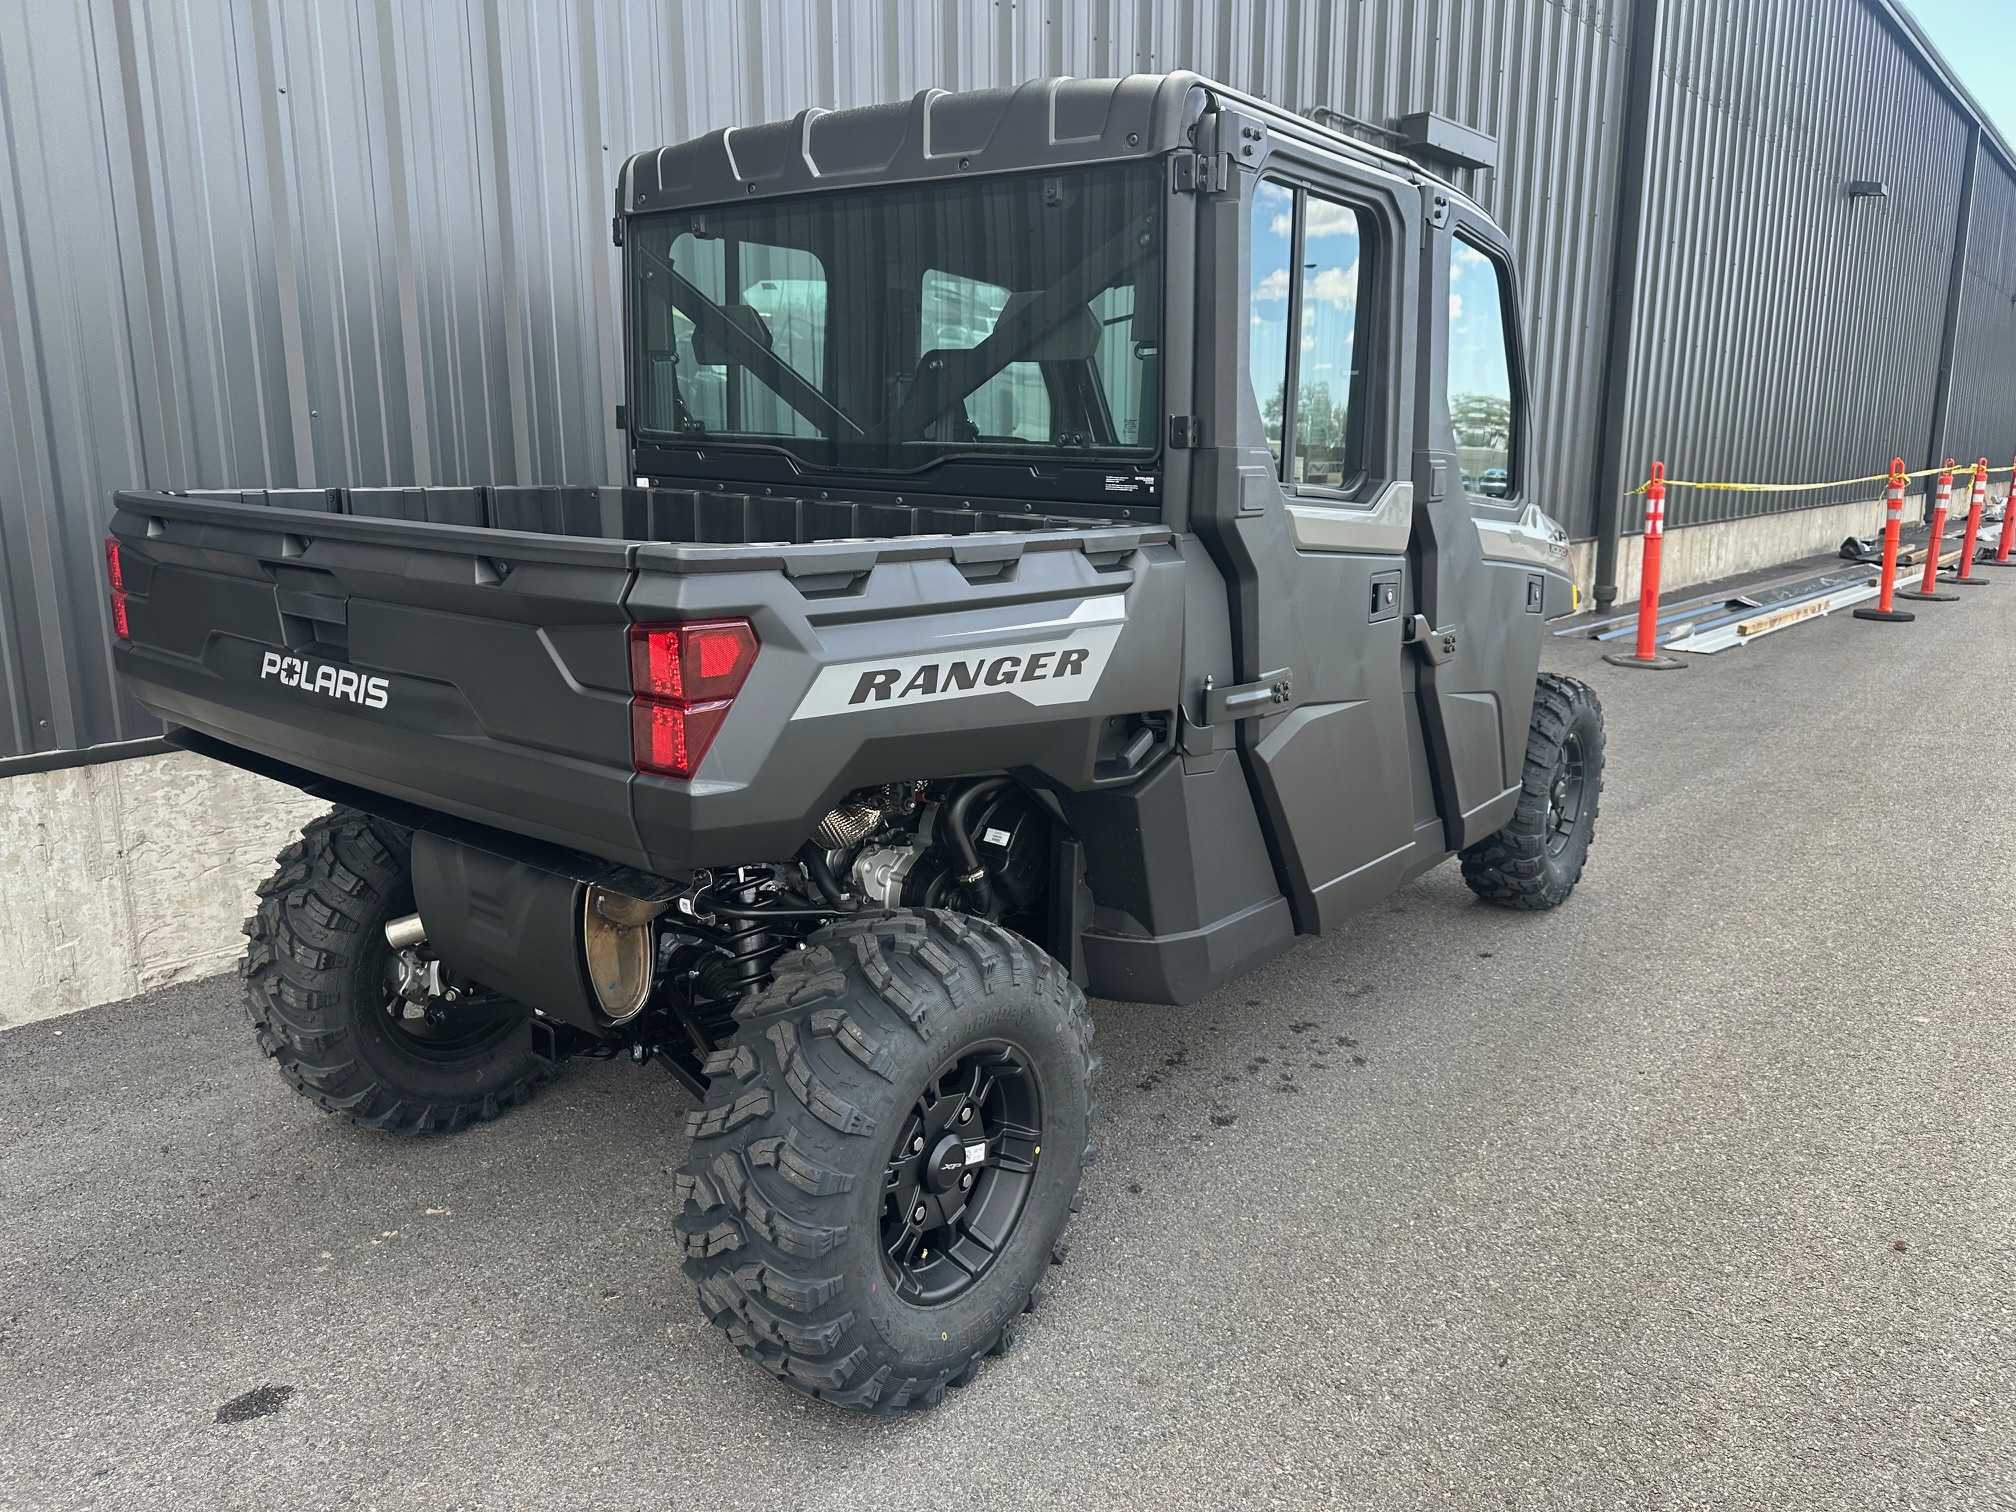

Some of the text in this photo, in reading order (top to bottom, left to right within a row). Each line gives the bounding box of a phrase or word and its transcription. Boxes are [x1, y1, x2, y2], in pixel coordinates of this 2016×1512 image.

[1548, 525, 1567, 542] XP
[260, 651, 390, 709] POLARIS
[847, 648, 1090, 706] RANGER
[940, 1162, 963, 1171] XP
